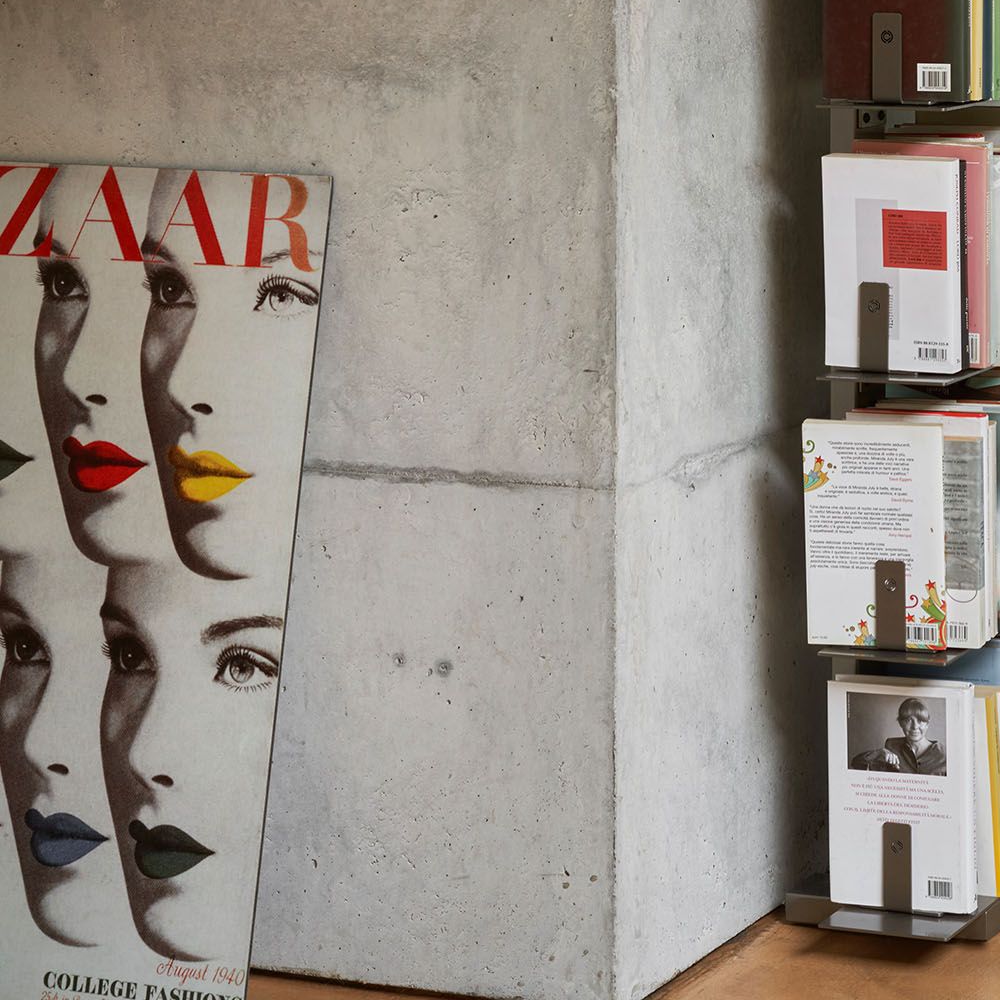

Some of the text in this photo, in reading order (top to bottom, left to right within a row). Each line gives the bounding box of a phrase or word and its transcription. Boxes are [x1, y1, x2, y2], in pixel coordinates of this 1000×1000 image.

[43, 971, 241, 1000] COLLEGE FASHIO
[156, 957, 245, 986] August 1940
